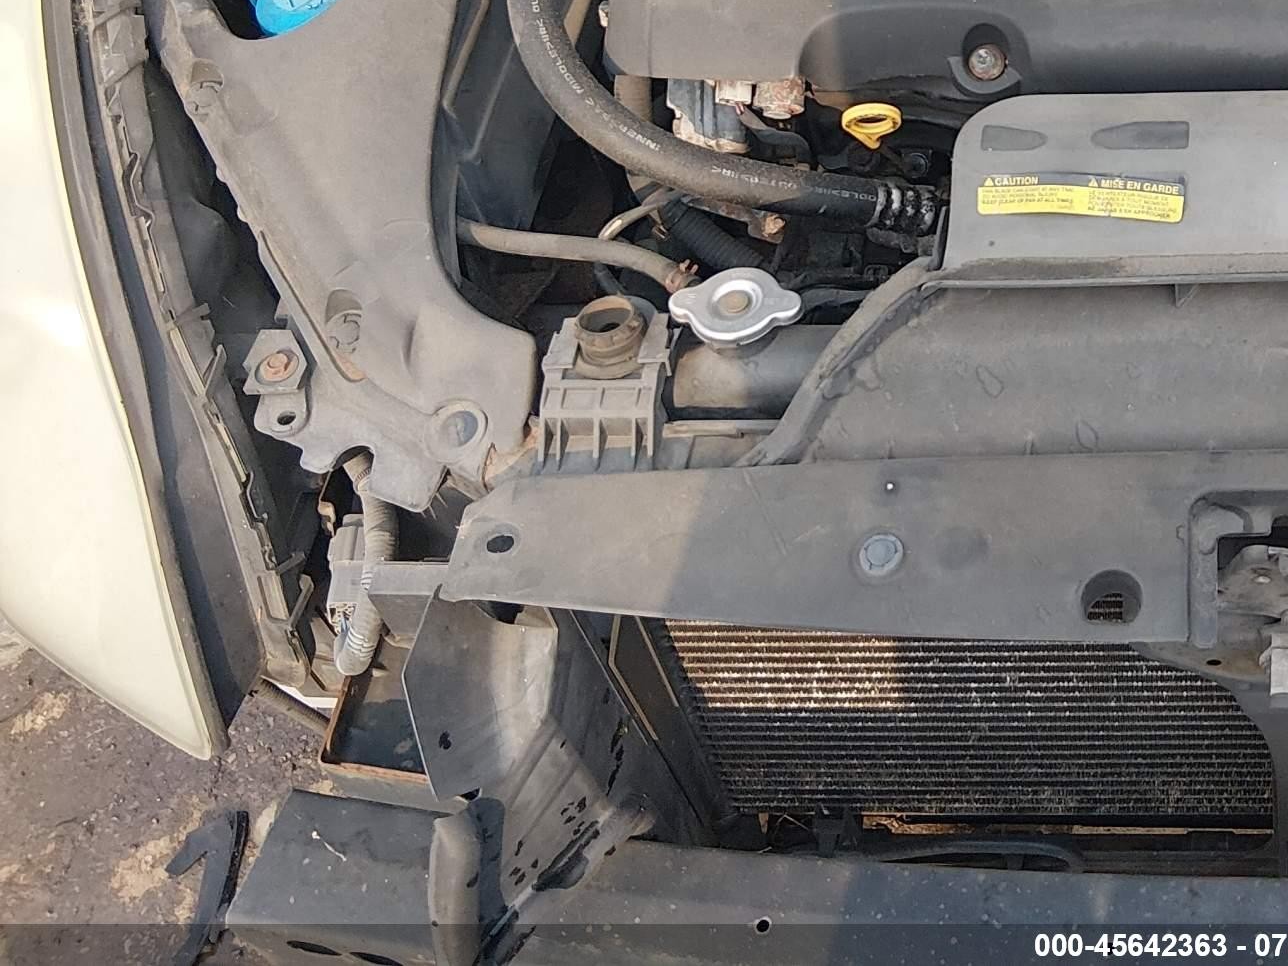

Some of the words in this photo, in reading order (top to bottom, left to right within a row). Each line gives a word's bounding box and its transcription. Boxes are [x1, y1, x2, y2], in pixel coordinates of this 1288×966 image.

[994, 176, 1039, 186] CAUTION
[1100, 179, 1125, 189] MISE
[1126, 180, 1141, 190] EN
[1143, 182, 1179, 195] GARDE
